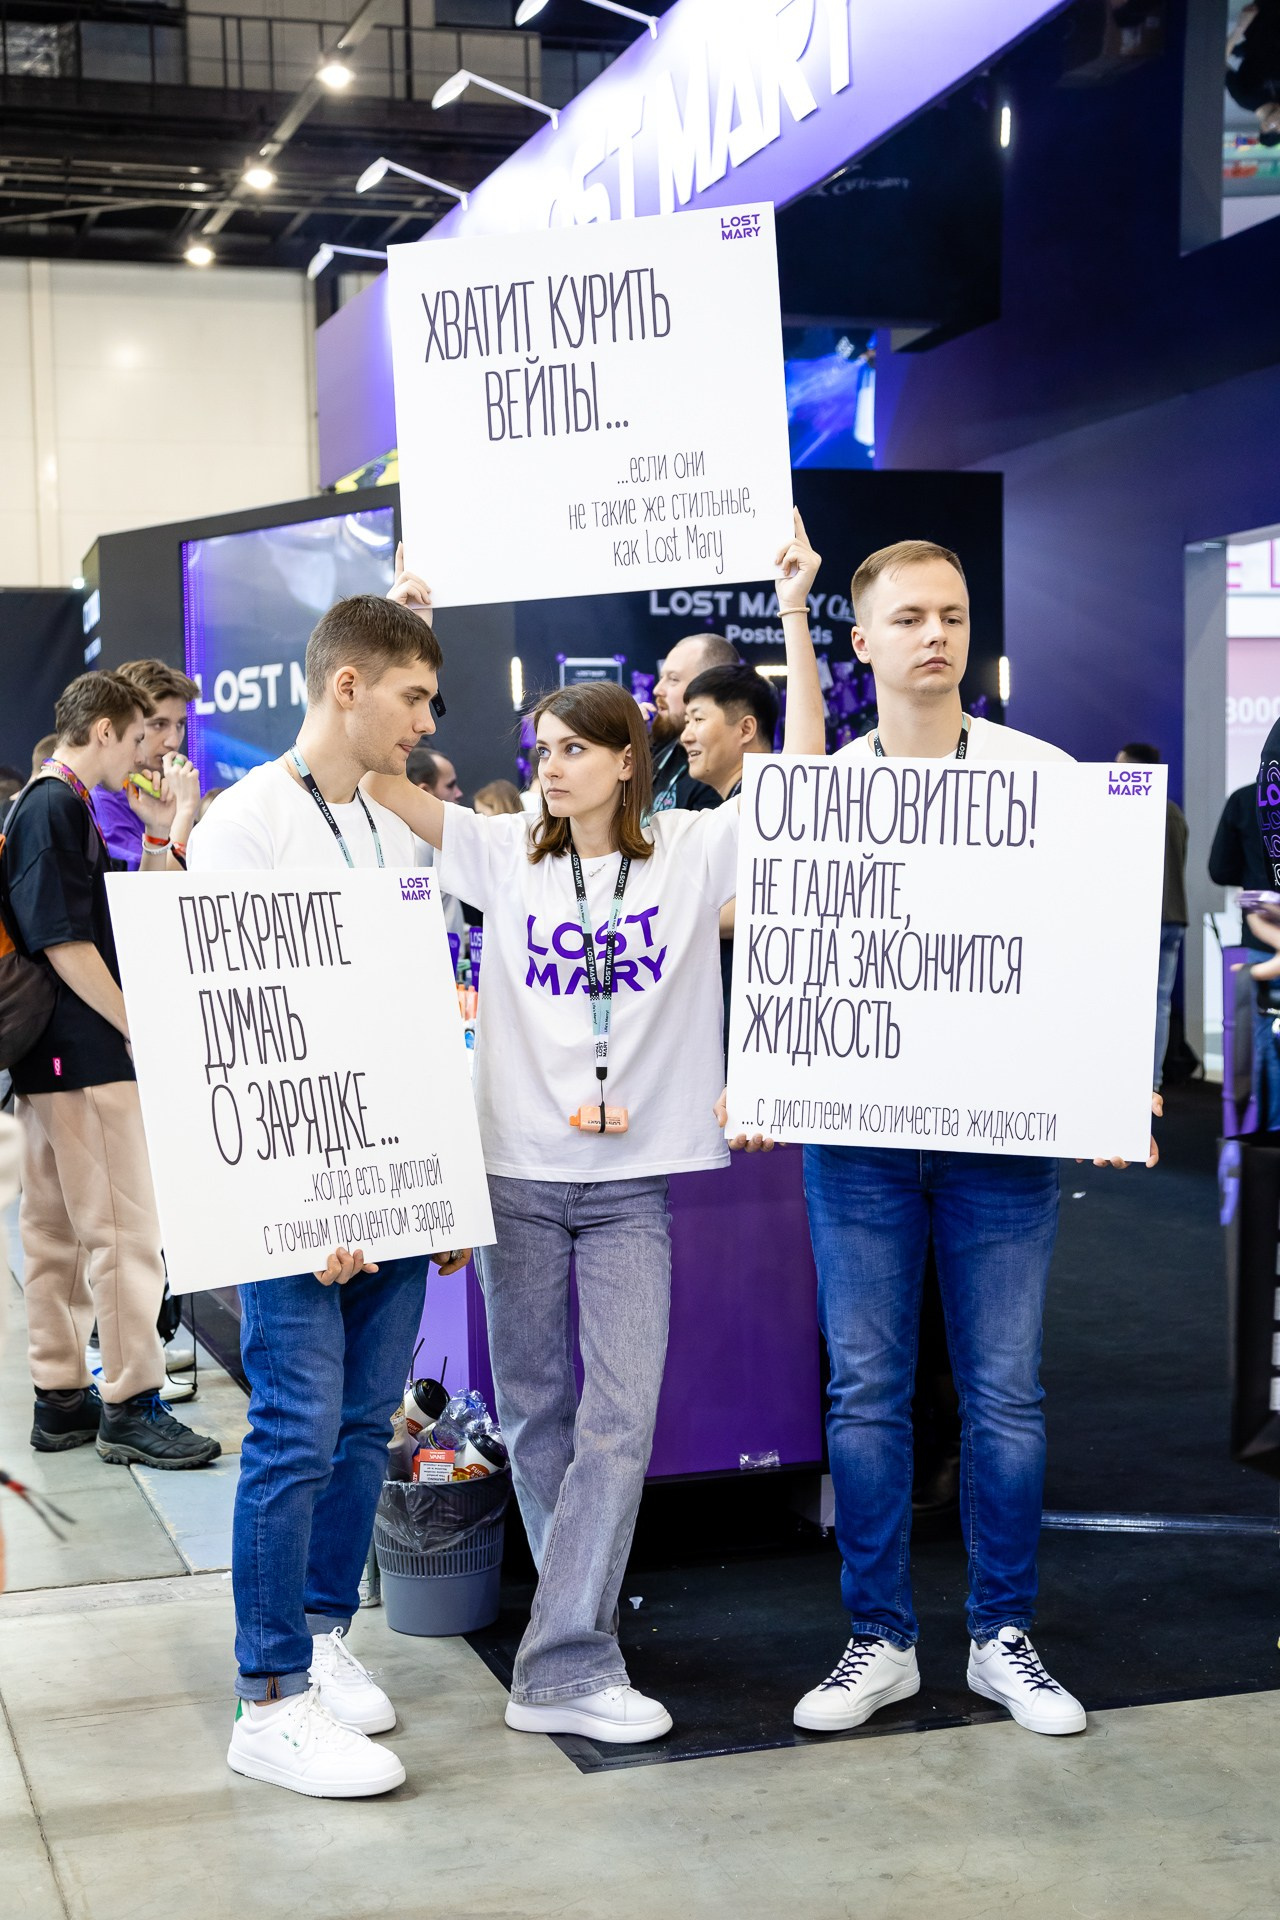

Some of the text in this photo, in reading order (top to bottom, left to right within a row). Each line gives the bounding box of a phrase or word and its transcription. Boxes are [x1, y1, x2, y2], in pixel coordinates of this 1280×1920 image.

[721, 214, 760, 228] LOST
[722, 226, 761, 240] MARY
[421, 267, 671, 363] ХВАТИТ КУРИТЬ
[485, 355, 629, 441] ВЕЙПЫ...
[617, 450, 705, 485] ...если они
[568, 486, 756, 530] не такие же стильные,
[613, 524, 724, 575] как Lost Mary
[650, 591, 733, 616] LOST
[725, 624, 833, 645] Postcds
[194, 663, 283, 715] LOST
[1108, 784, 1152, 796] MARY
[1109, 771, 1152, 783] LOST
[312, 787, 335, 825] LOST MARY
[755, 763, 1037, 848] ОСТАНОВИТЕСЬ!
[400, 877, 429, 888] LOST
[401, 890, 431, 900] MARY
[572, 854, 583, 888] LOST MARY
[617, 871, 627, 888] LOST
[751, 852, 911, 930] НЕ ГАДАЙТЕ,
[178, 891, 352, 975] ПРЕКРАТИТЕ
[527, 906, 659, 960] LOST
[526, 945, 667, 995] MARY
[589, 964, 597, 986] MARY
[748, 924, 1023, 997] КОГДА ЗАКОНЧИТСЯ
[199, 985, 307, 1085] ДУМАТЬ
[742, 993, 900, 1066] ЖИДКОСТЬ
[211, 1070, 399, 1168] О ЗАРЯДКЕ...
[770, 1098, 852, 1134] дисплеем
[859, 1104, 959, 1137] количества
[967, 1108, 1057, 1147] жидкости
[304, 1153, 443, 1206] ...когда есть дисплей
[263, 1200, 455, 1255] с точным процентом заряда
